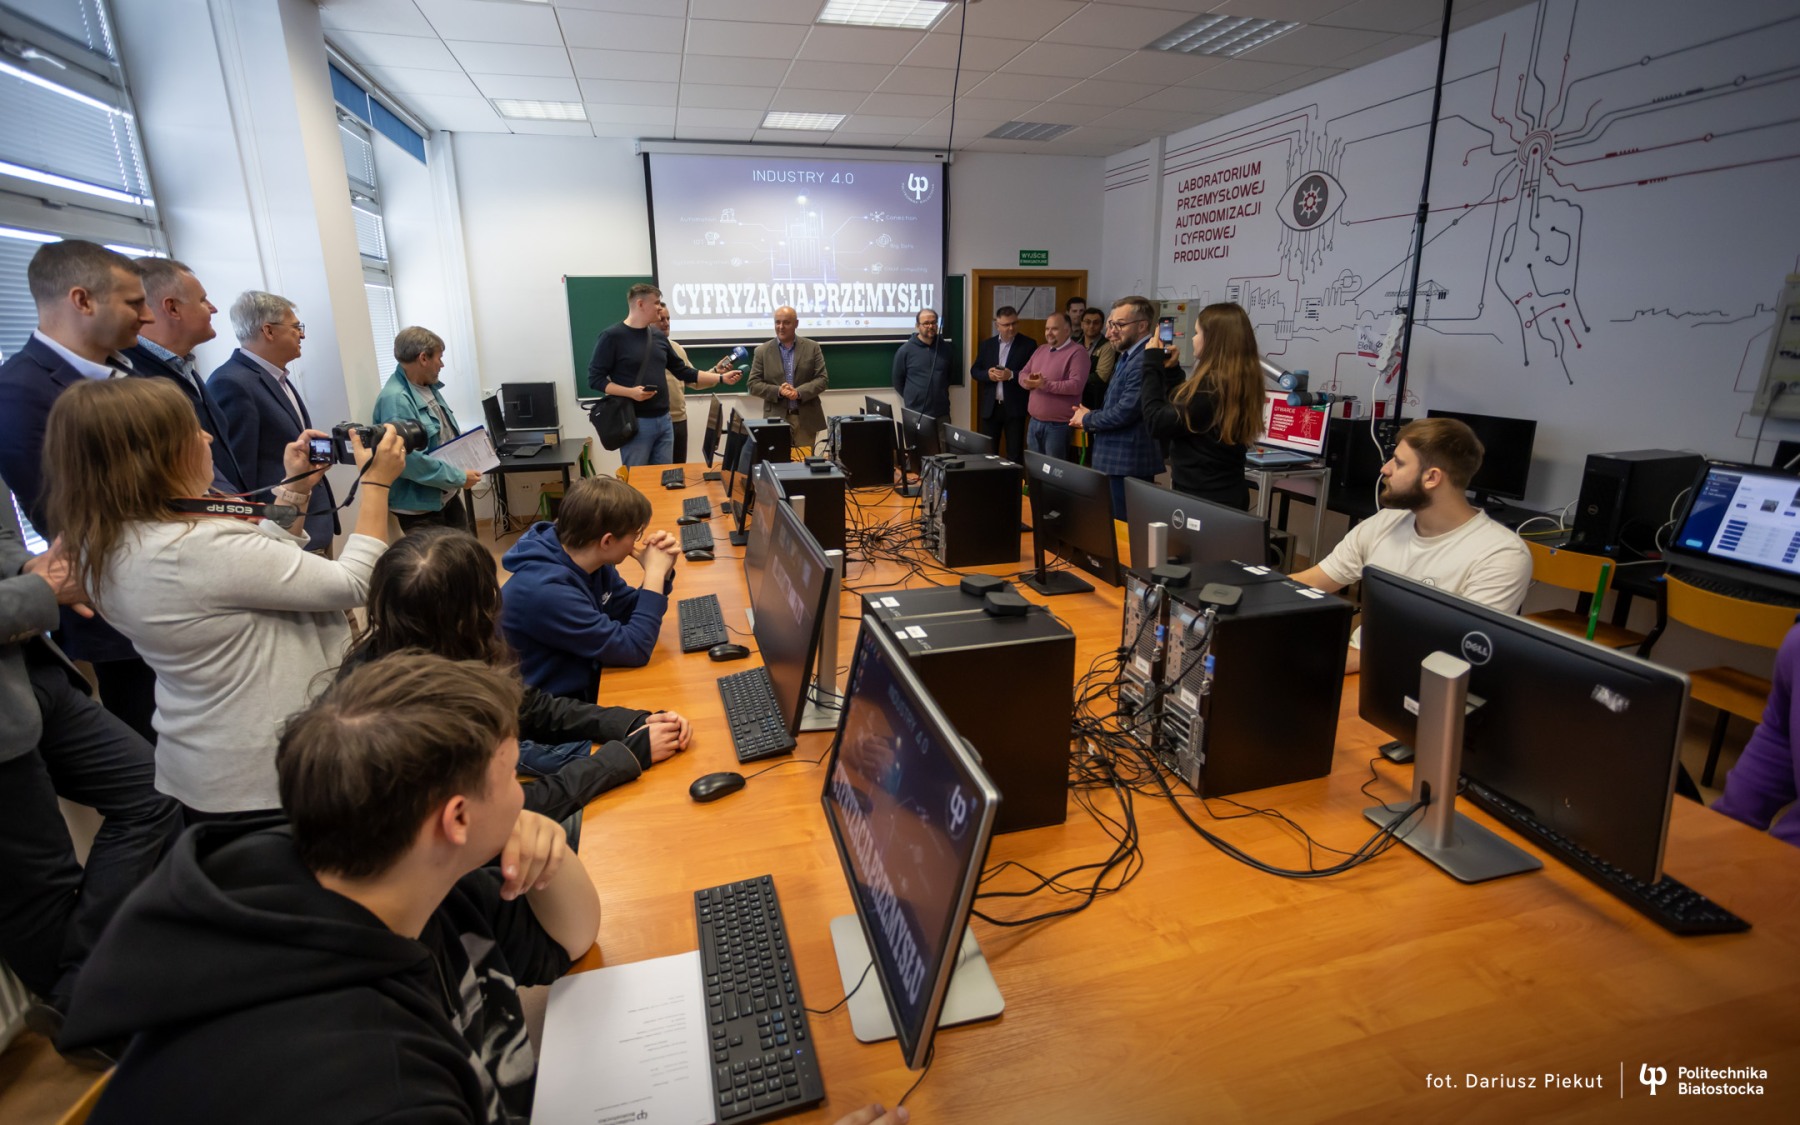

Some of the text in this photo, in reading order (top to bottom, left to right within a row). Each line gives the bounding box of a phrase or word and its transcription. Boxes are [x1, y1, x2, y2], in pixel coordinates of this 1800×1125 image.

[752, 169, 855, 185] INDUSTRY 4.0
[1178, 160, 1262, 194] LABORATORIUM
[1177, 180, 1265, 211] PRZEMYSŁOWEJ
[1175, 202, 1261, 229] AUTONOMIZACJI
[1174, 225, 1236, 247] I CYFROWEJ
[1173, 245, 1230, 263] PRODUKCJI
[672, 281, 934, 315] CYFRYZACJA PRZEMYSŁU
[206, 504, 253, 514] EOS RP
[1465, 640, 1488, 657] DELL
[867, 848, 926, 1006] PRZEMYSŁU
